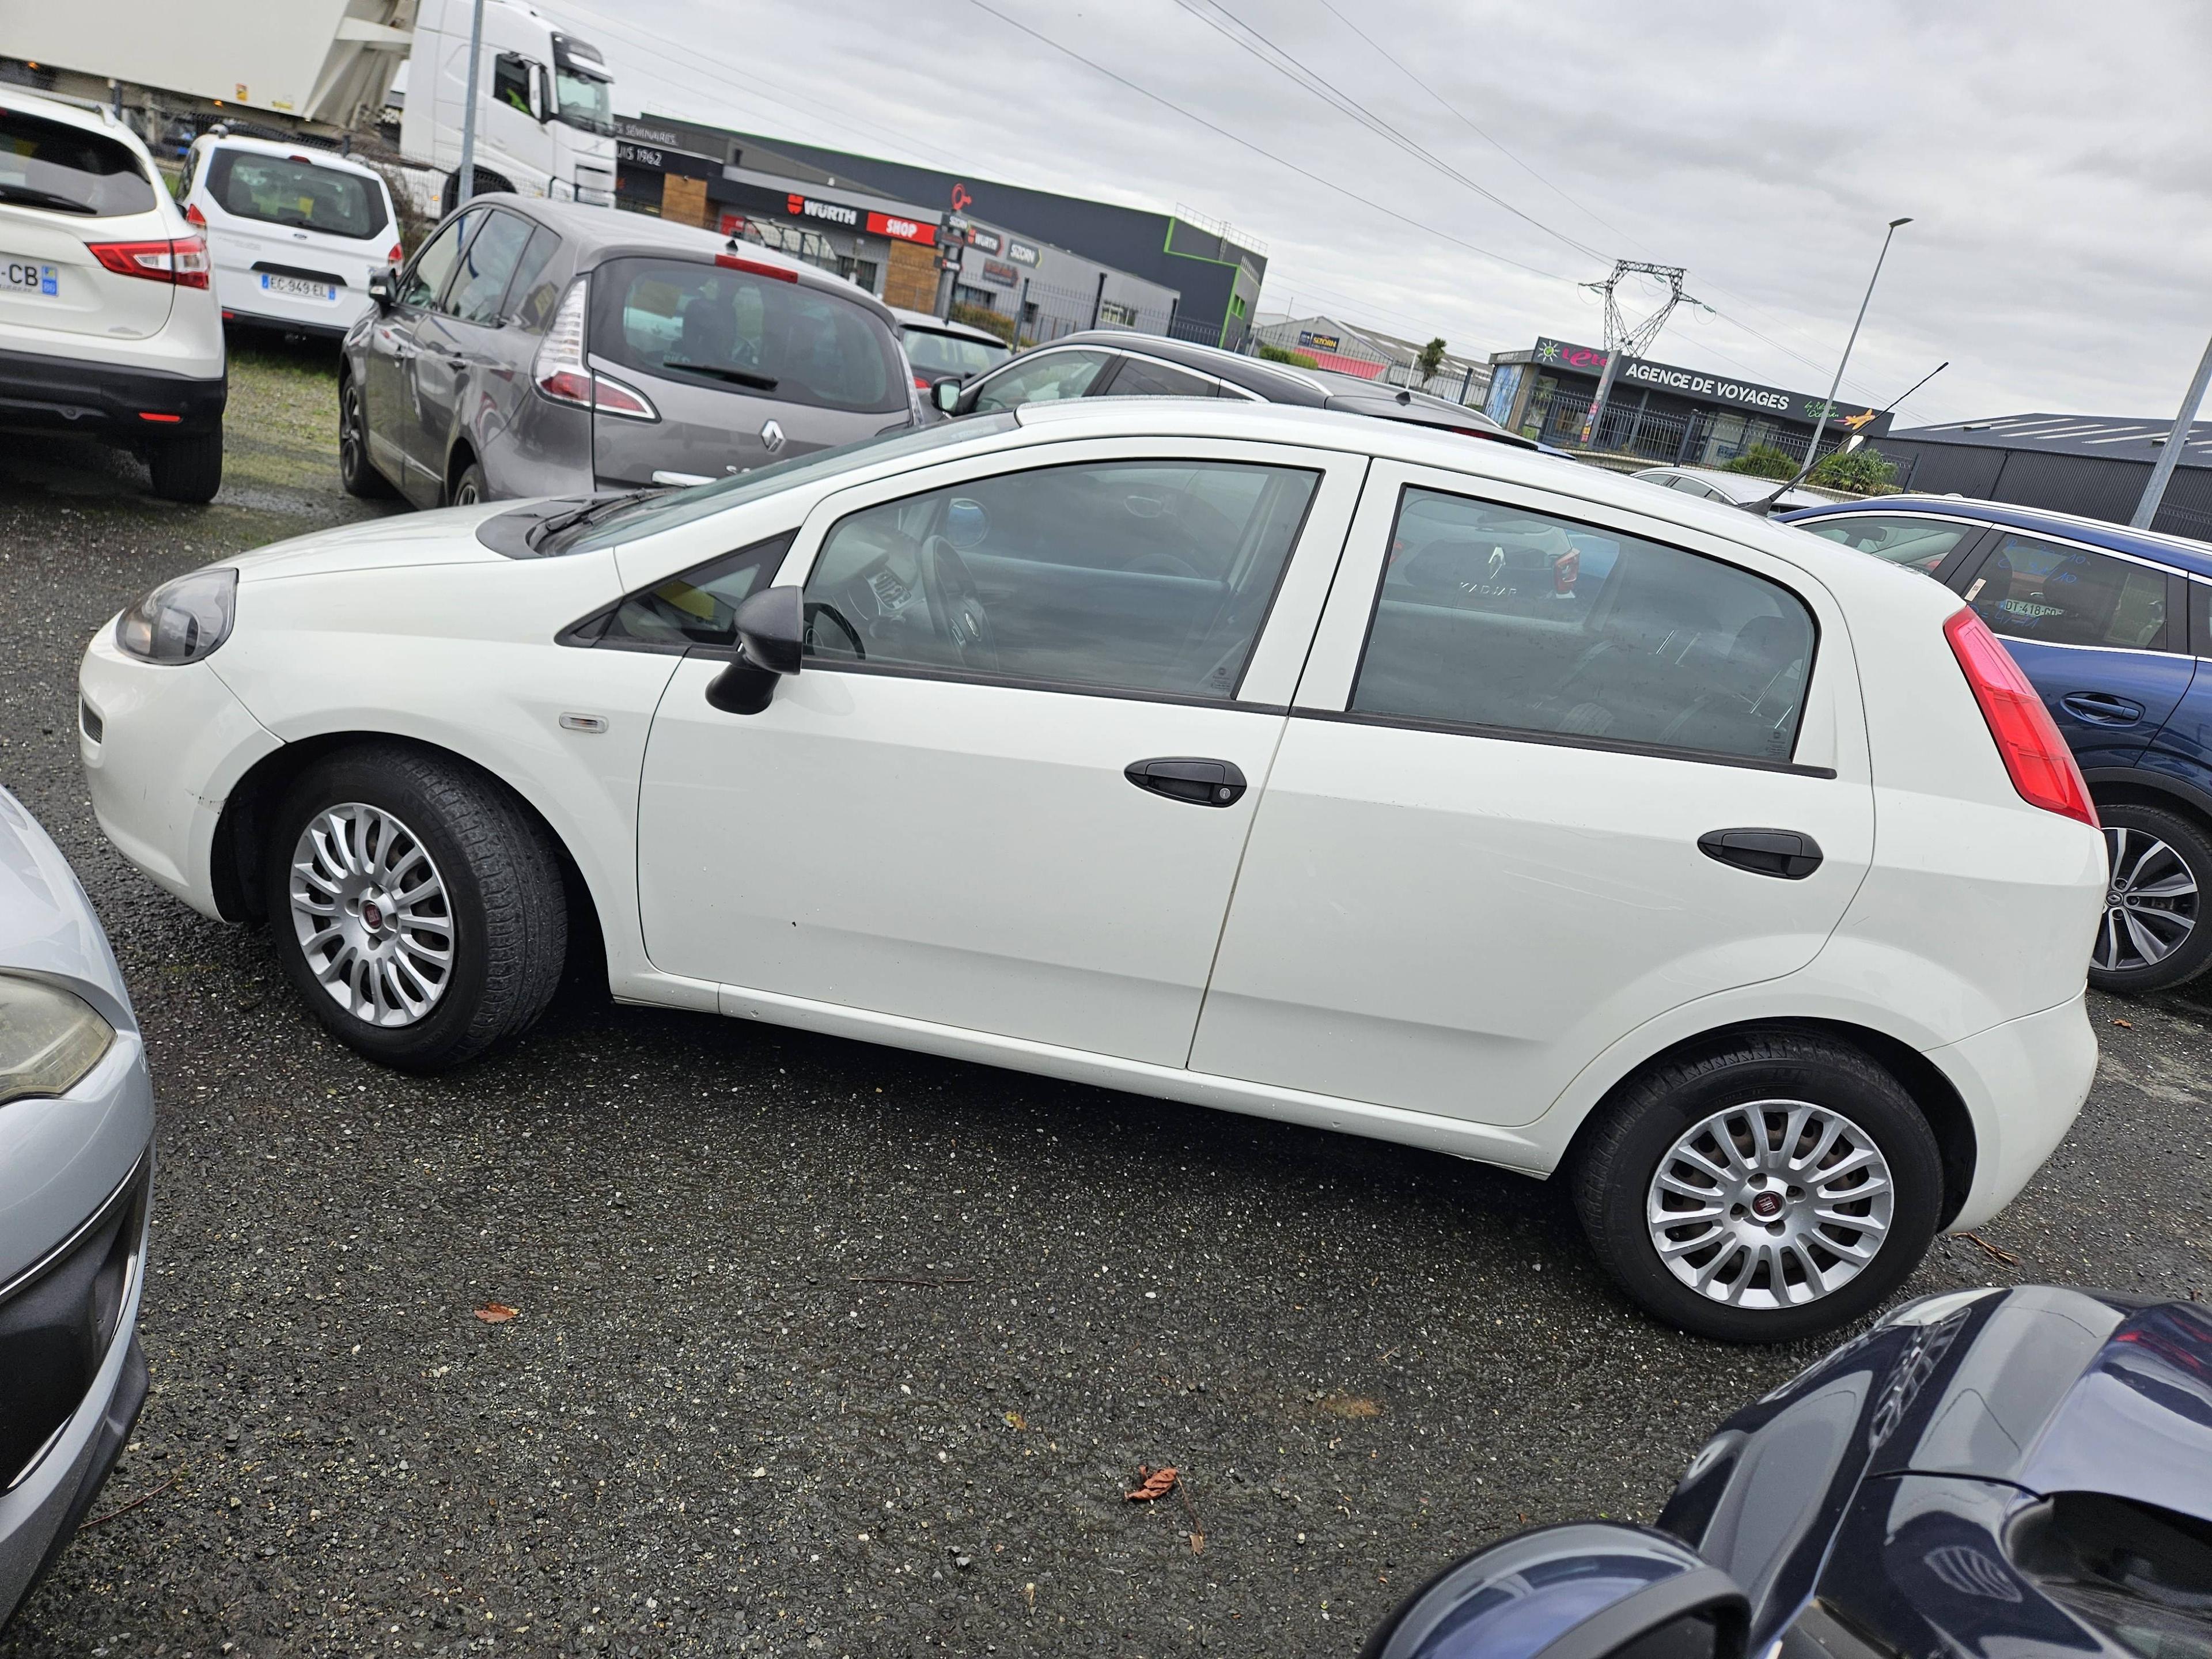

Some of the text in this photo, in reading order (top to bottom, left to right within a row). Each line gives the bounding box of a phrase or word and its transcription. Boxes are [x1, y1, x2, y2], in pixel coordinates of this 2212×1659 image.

[637, 148, 662, 166] 1962
[804, 200, 857, 225] WÜRTH
[886, 219, 917, 238] SHOP
[1626, 363, 1790, 411] AGENCE DE VOYAGES
[1758, 1196, 1776, 1213] FIAT
